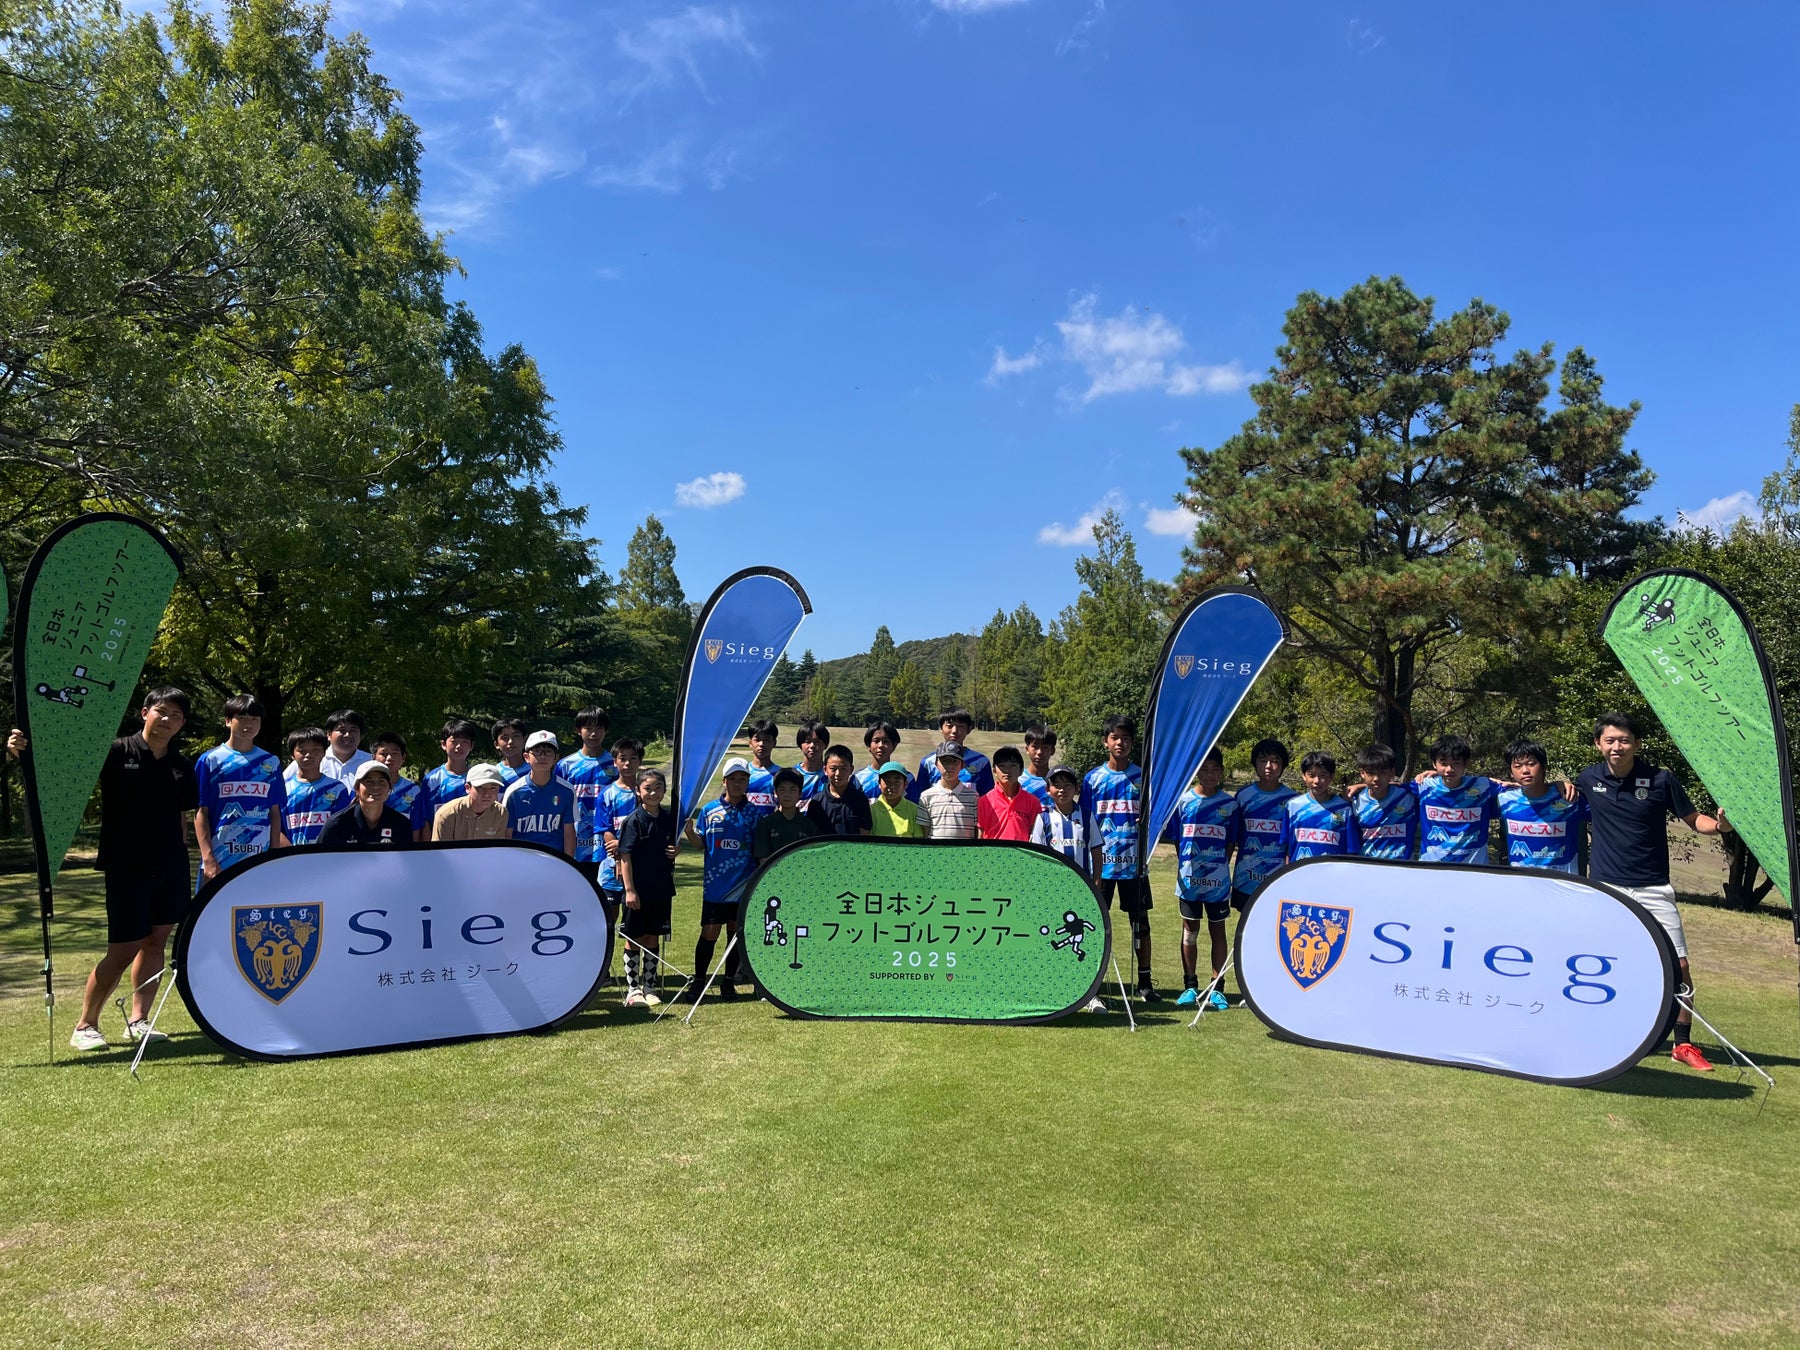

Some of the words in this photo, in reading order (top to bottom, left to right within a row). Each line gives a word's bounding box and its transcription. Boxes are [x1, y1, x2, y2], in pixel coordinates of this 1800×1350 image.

[80, 539, 129, 655] フットゴルフツアー
[42, 608, 66, 646] 全日本
[60, 601, 88, 650] ジュニア
[1697, 616, 1726, 650] 全日本
[101, 617, 127, 662] 2025
[725, 642, 775, 660] Sieg
[1683, 625, 1719, 666] ジュニア
[1197, 658, 1252, 676] Sieg
[1651, 646, 1684, 685] 2025
[1668, 634, 1746, 741] フットゴルフツアー
[517, 814, 561, 833] ITALIA
[722, 840, 738, 849] IKS
[1185, 875, 1221, 888] TSUBATA
[249, 907, 308, 922] Sieg
[836, 890, 1012, 917] 全日本ジュニア
[1291, 904, 1340, 921] Sieg
[347, 905, 575, 956] Sieg
[822, 921, 1030, 946] フットゴルフツアー
[892, 951, 957, 967] 2025
[1370, 921, 1618, 1005] Sieg
[377, 966, 457, 988] 株式会社
[466, 961, 520, 979] ジーク
[869, 972, 921, 981] SUPPORTED
[923, 972, 935, 981] BY
[1393, 982, 1473, 1007] 株式会社
[1485, 993, 1545, 1015] ジーク
